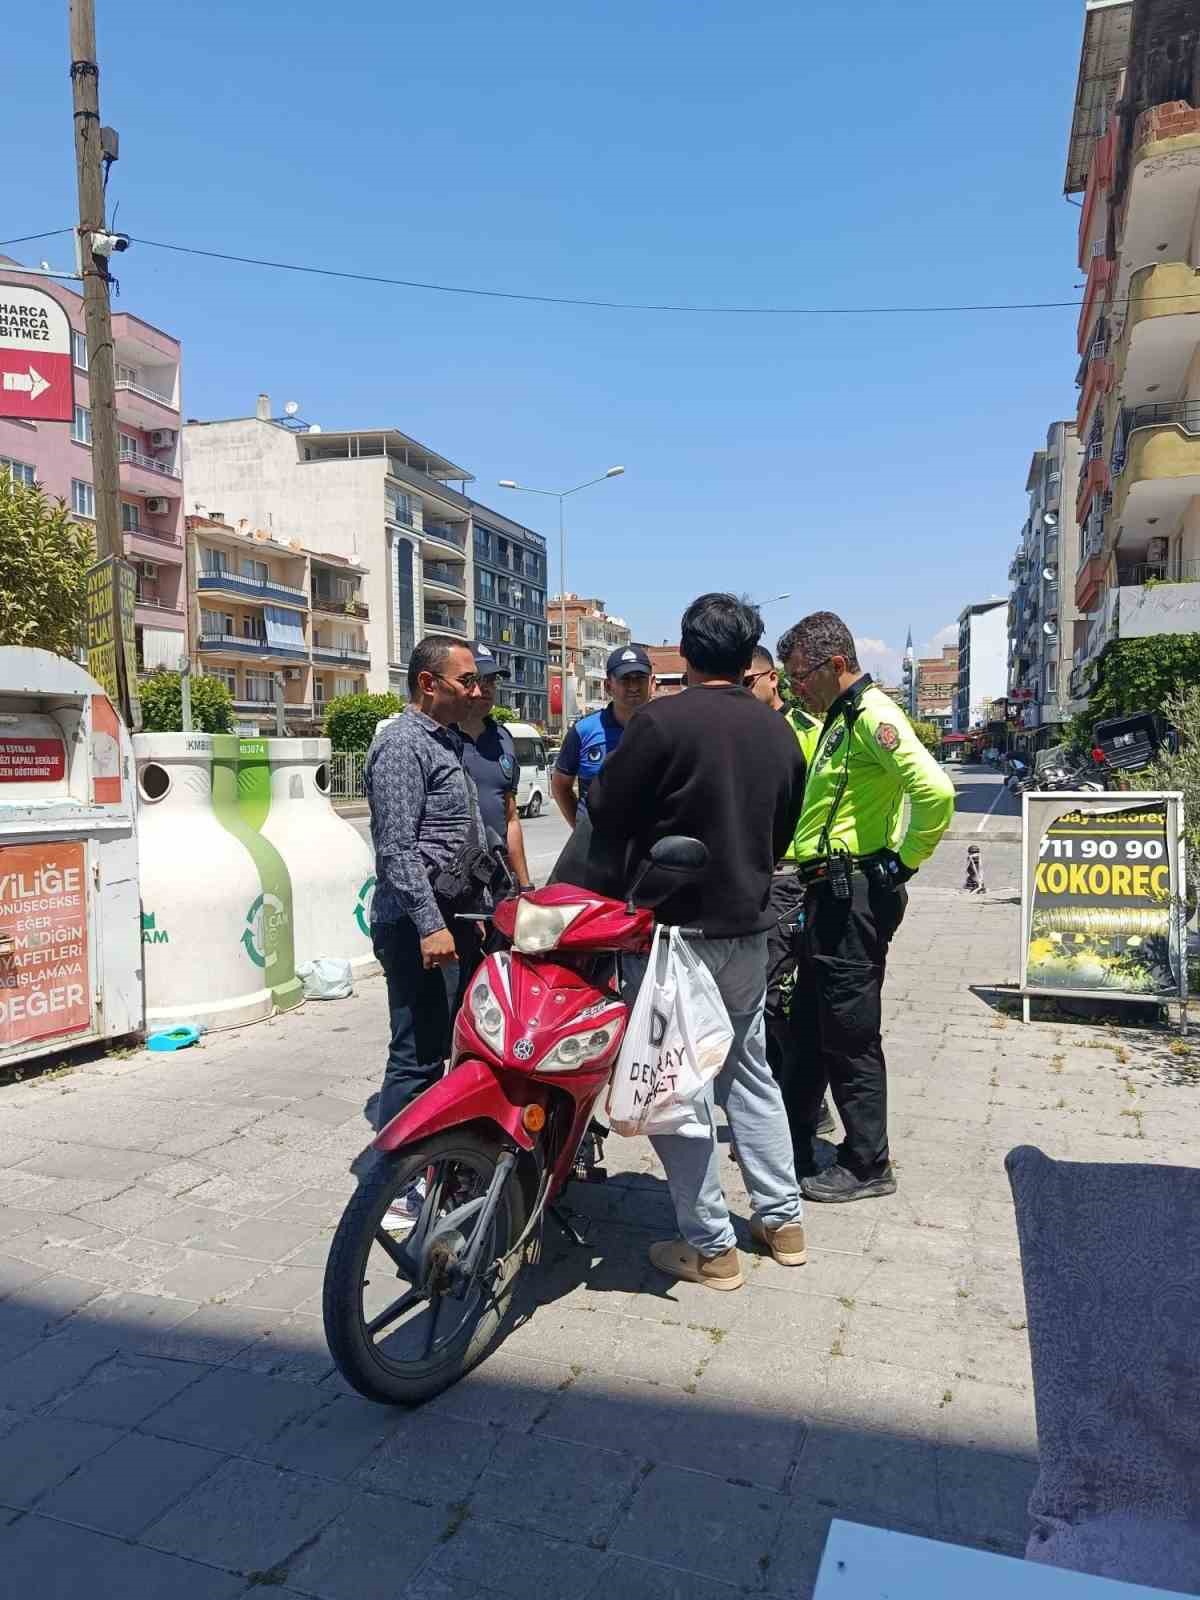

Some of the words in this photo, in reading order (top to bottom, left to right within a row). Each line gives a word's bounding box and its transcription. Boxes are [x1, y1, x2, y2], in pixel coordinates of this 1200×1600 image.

[0, 304, 48, 318] HARCA
[0, 315, 49, 330] HARCA
[1081, 840, 1118, 859] 90
[1125, 840, 1163, 859] 90
